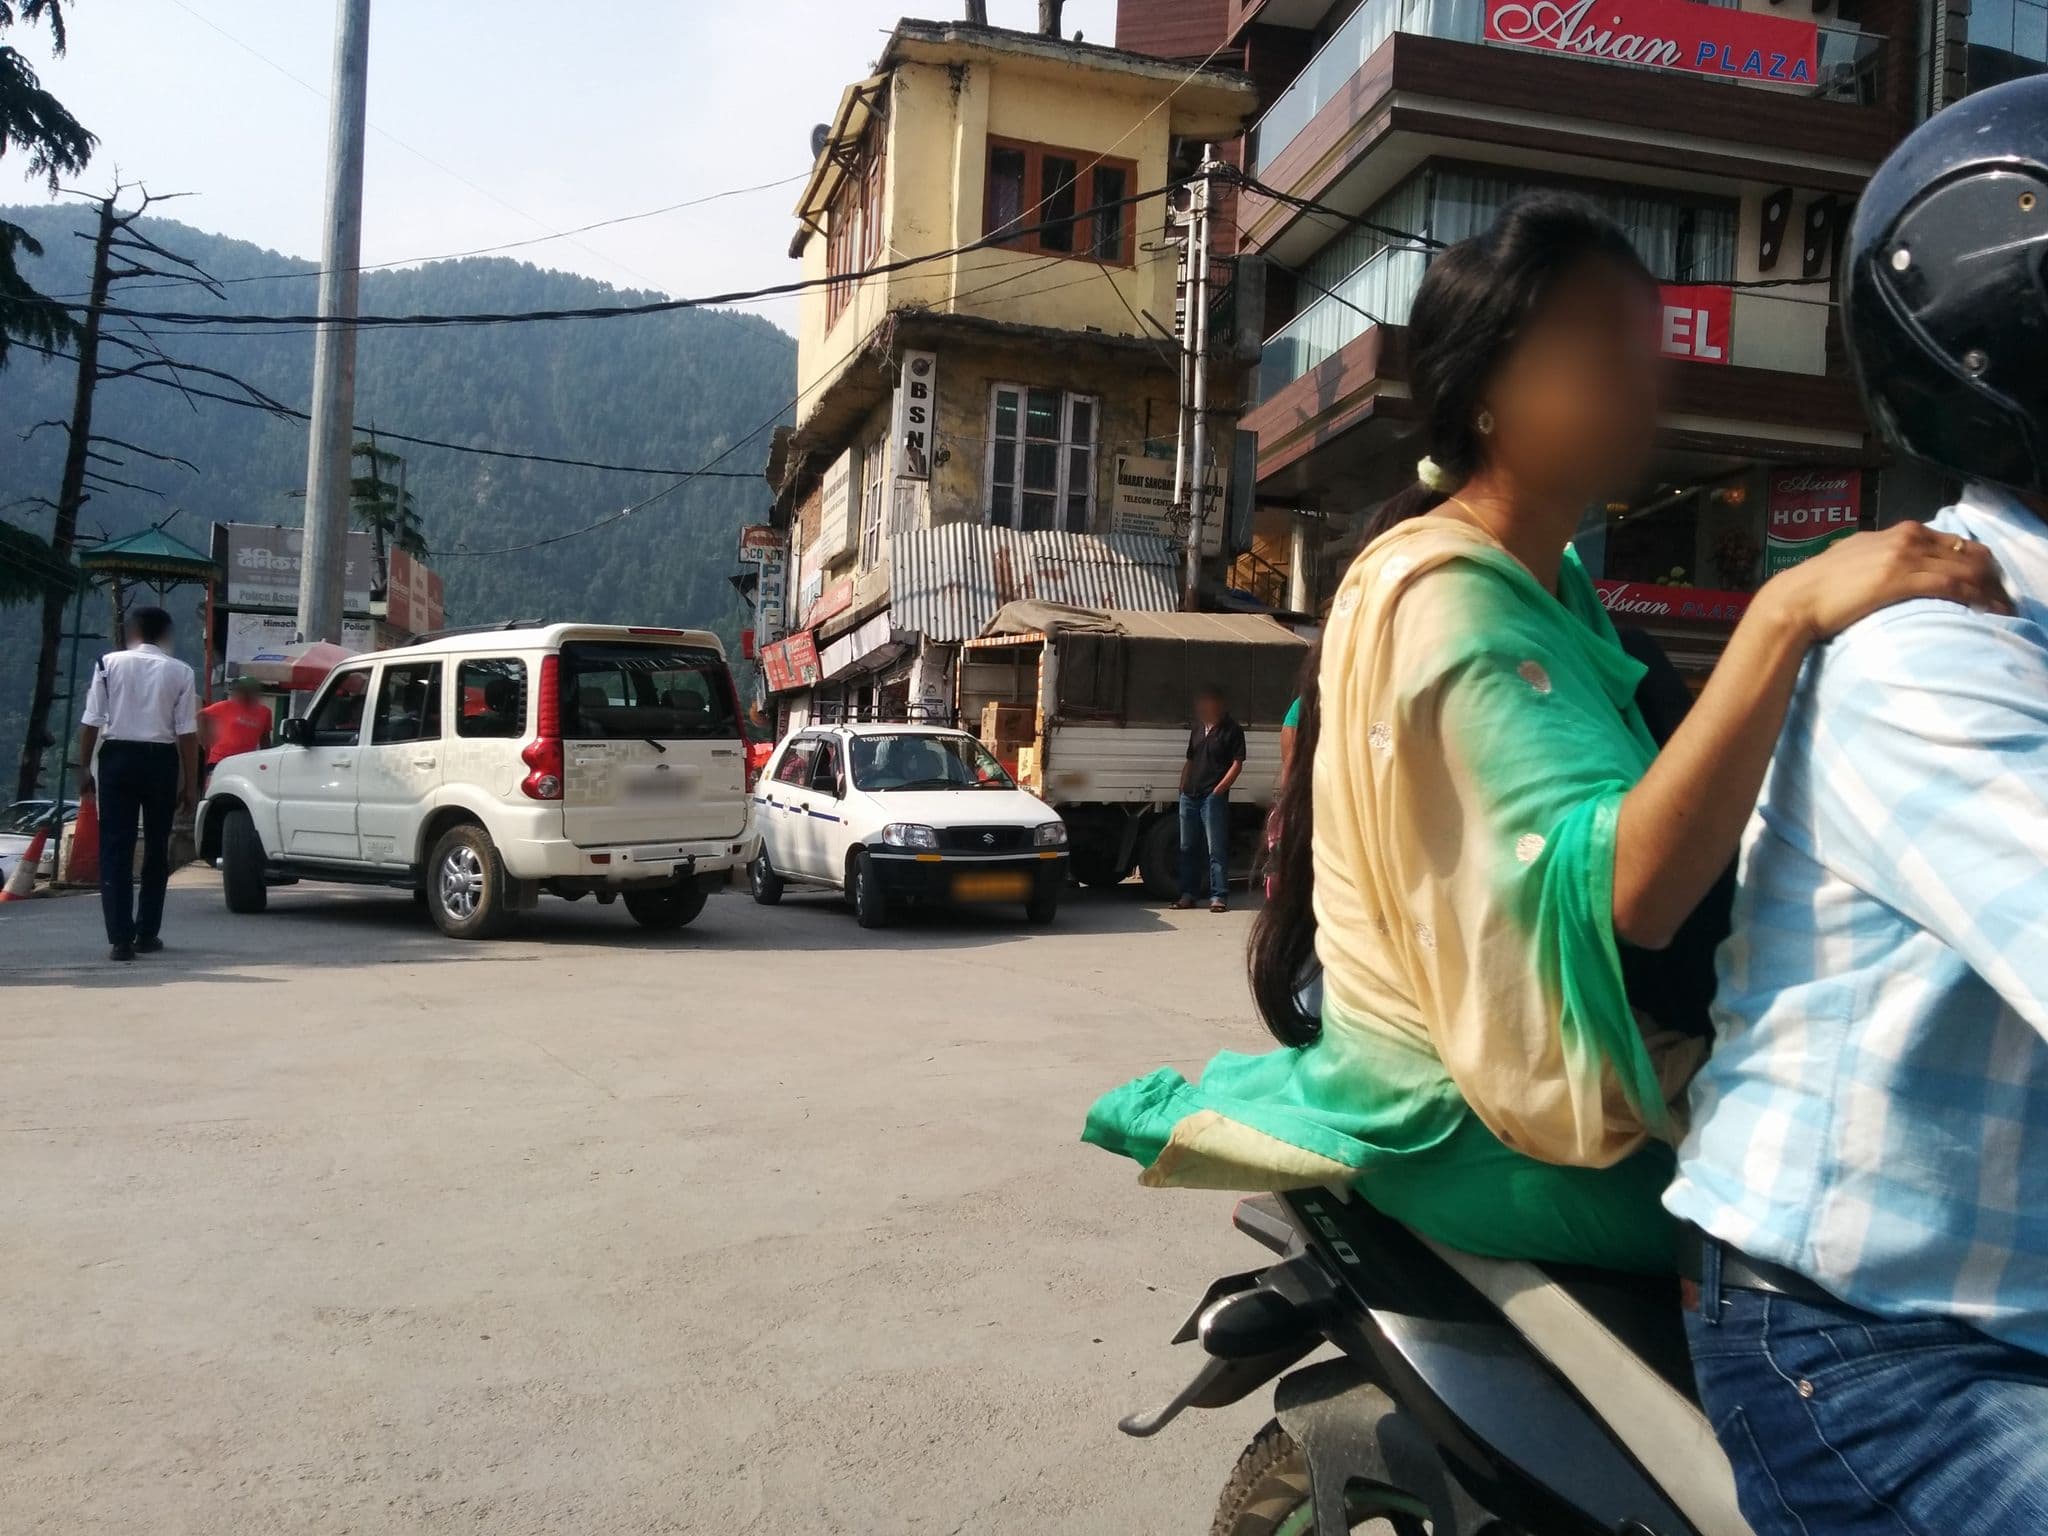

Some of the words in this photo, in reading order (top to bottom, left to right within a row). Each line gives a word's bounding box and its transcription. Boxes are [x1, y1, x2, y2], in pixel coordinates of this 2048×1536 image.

[1493, 0, 1682, 66] Asian
[1696, 41, 1810, 81] PLAZA
[1662, 305, 1722, 359] EL
[1773, 505, 1858, 525] HOTEL
[1595, 583, 1672, 616] Asian
[1680, 601, 1744, 621] PLAZ
[263, 619, 297, 628] Himach
[343, 621, 372, 632] Police
[860, 734, 899, 743] TOURIST
[934, 735, 973, 744] VEHICLE
[1303, 1201, 1361, 1265] 150
